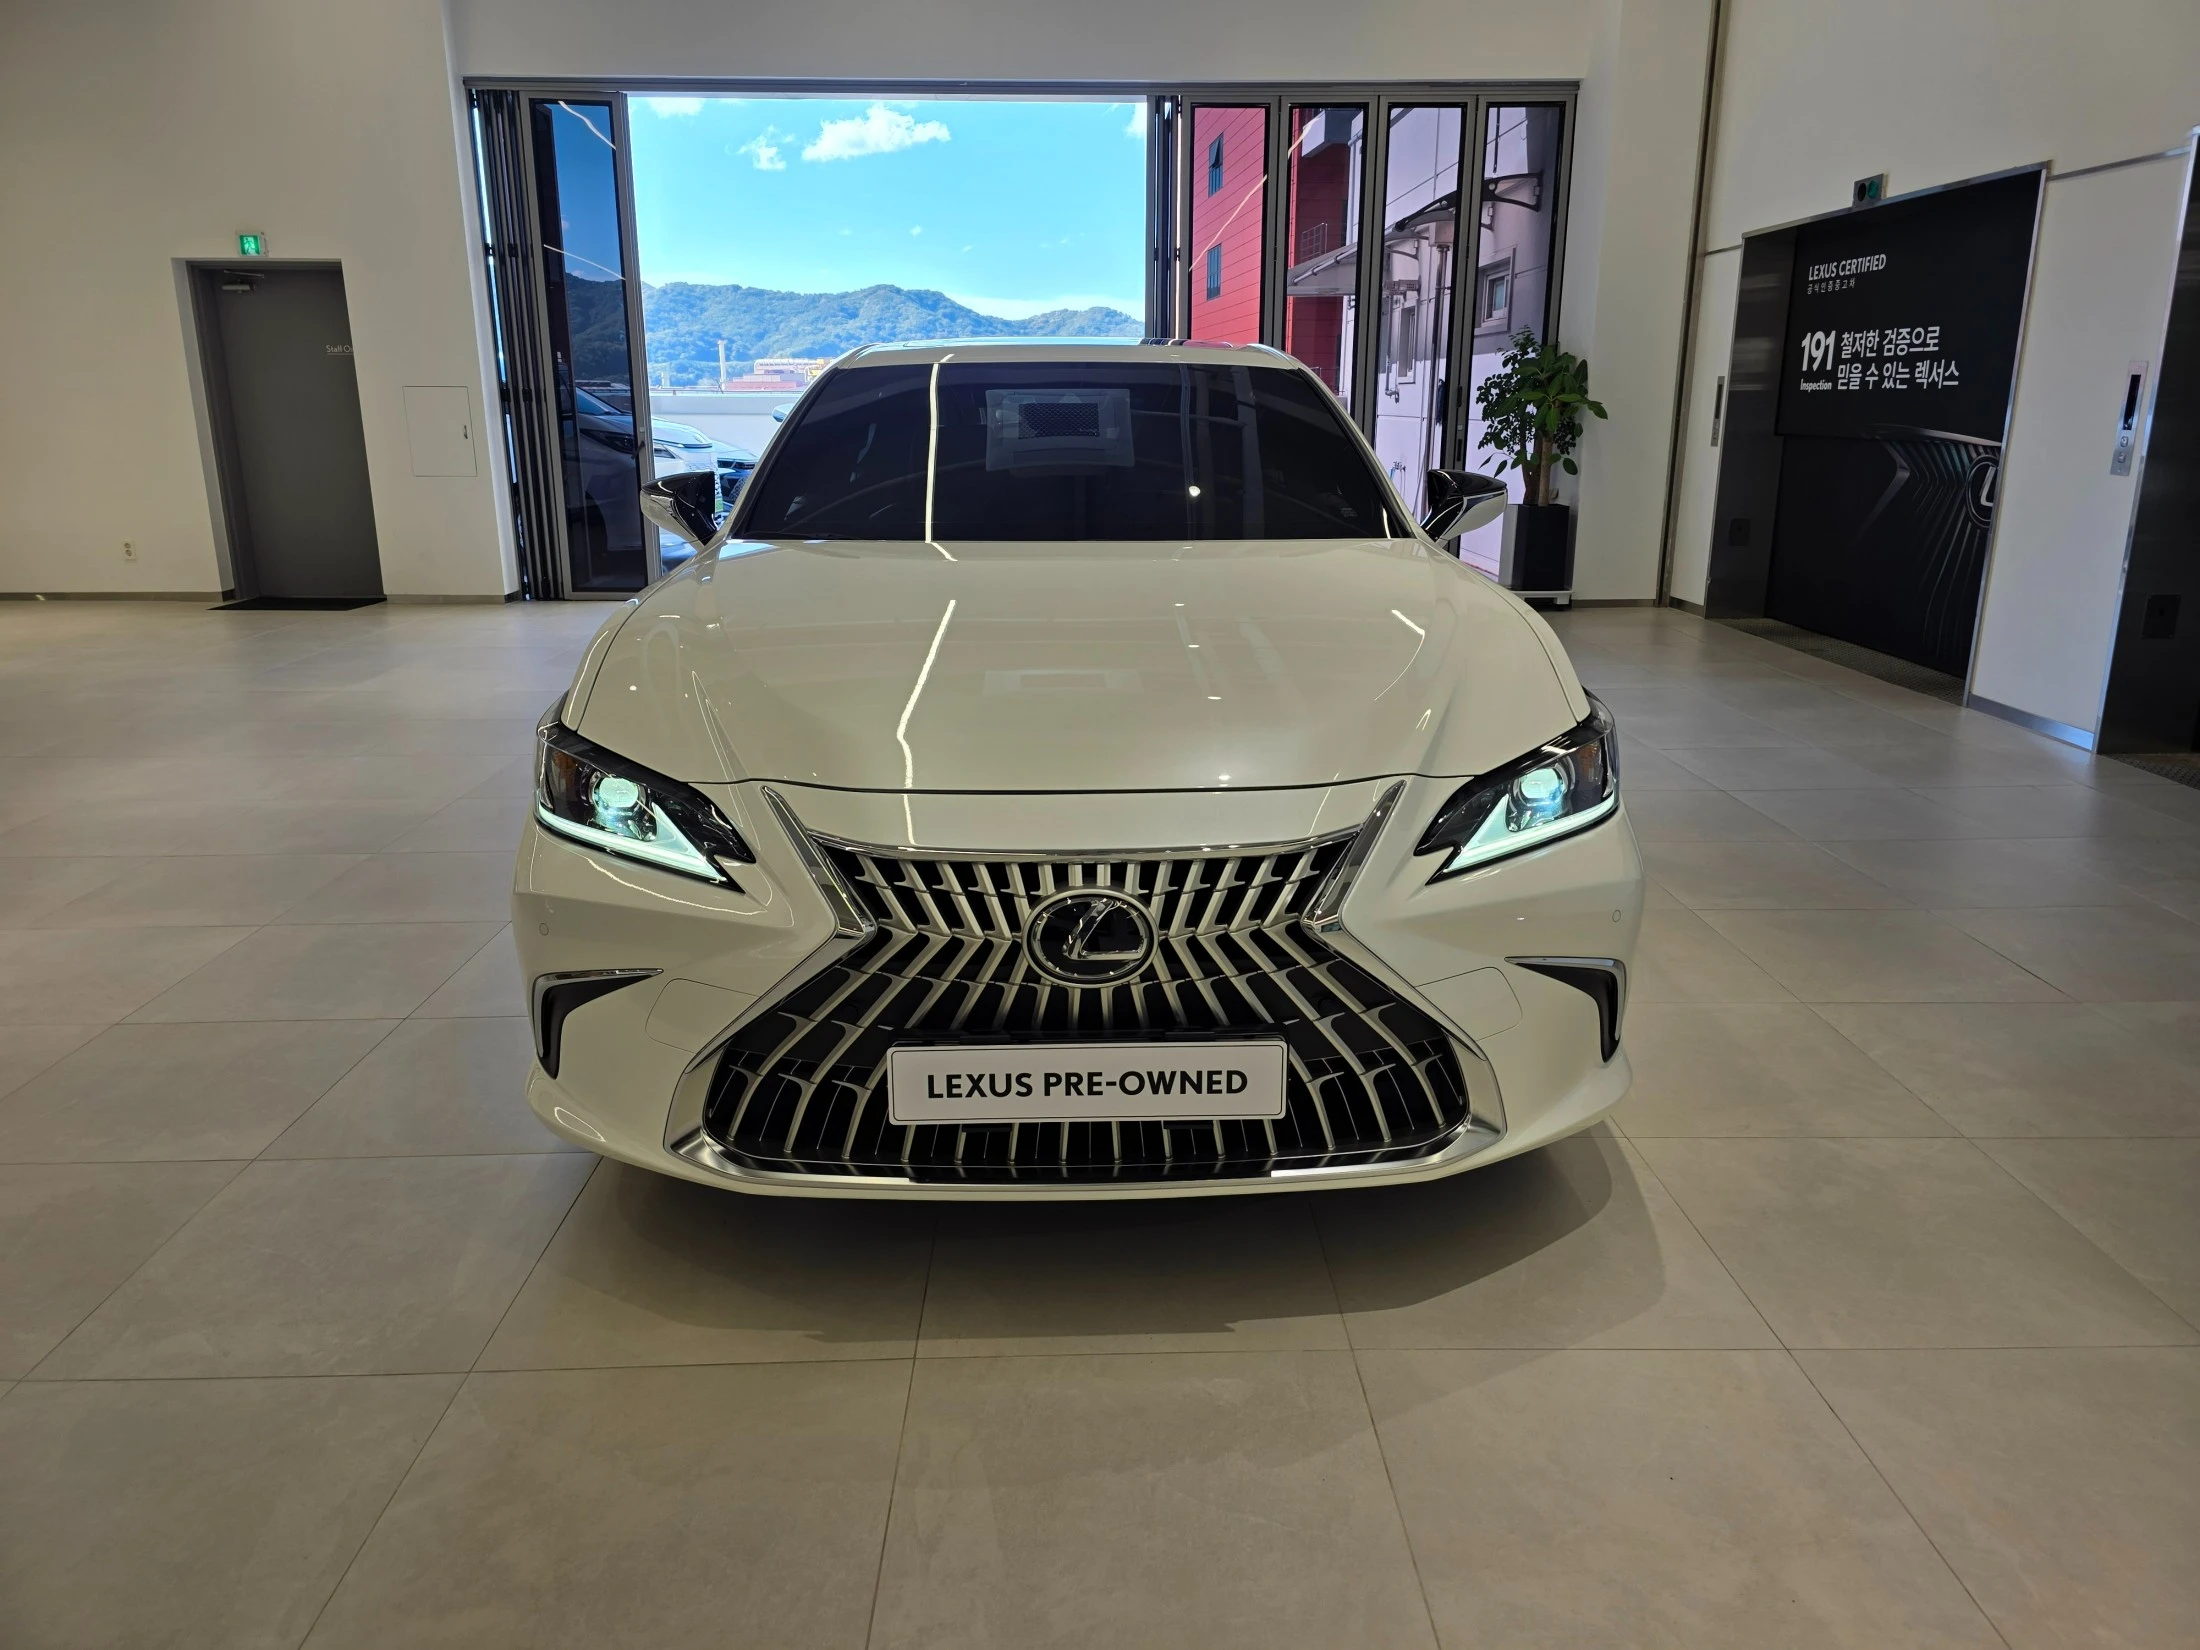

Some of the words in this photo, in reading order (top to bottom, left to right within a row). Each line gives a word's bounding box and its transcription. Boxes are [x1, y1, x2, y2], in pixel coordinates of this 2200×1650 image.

[1808, 261, 1838, 281] LEXUS
[1839, 253, 1887, 276] CERTIFIED
[1800, 329, 1836, 372] 191
[1840, 329, 1879, 359] 철저한
[1882, 325, 1940, 356] 검증으로
[1800, 378, 1833, 393] Inspection
[1837, 362, 1862, 390] 믿을
[1864, 362, 1879, 390] 수
[1881, 361, 1911, 389] 있는
[1914, 359, 1960, 390] 렉서스
[927, 1072, 1033, 1099] LEXUS
[1043, 1069, 1249, 1097] PRE-OWNED
